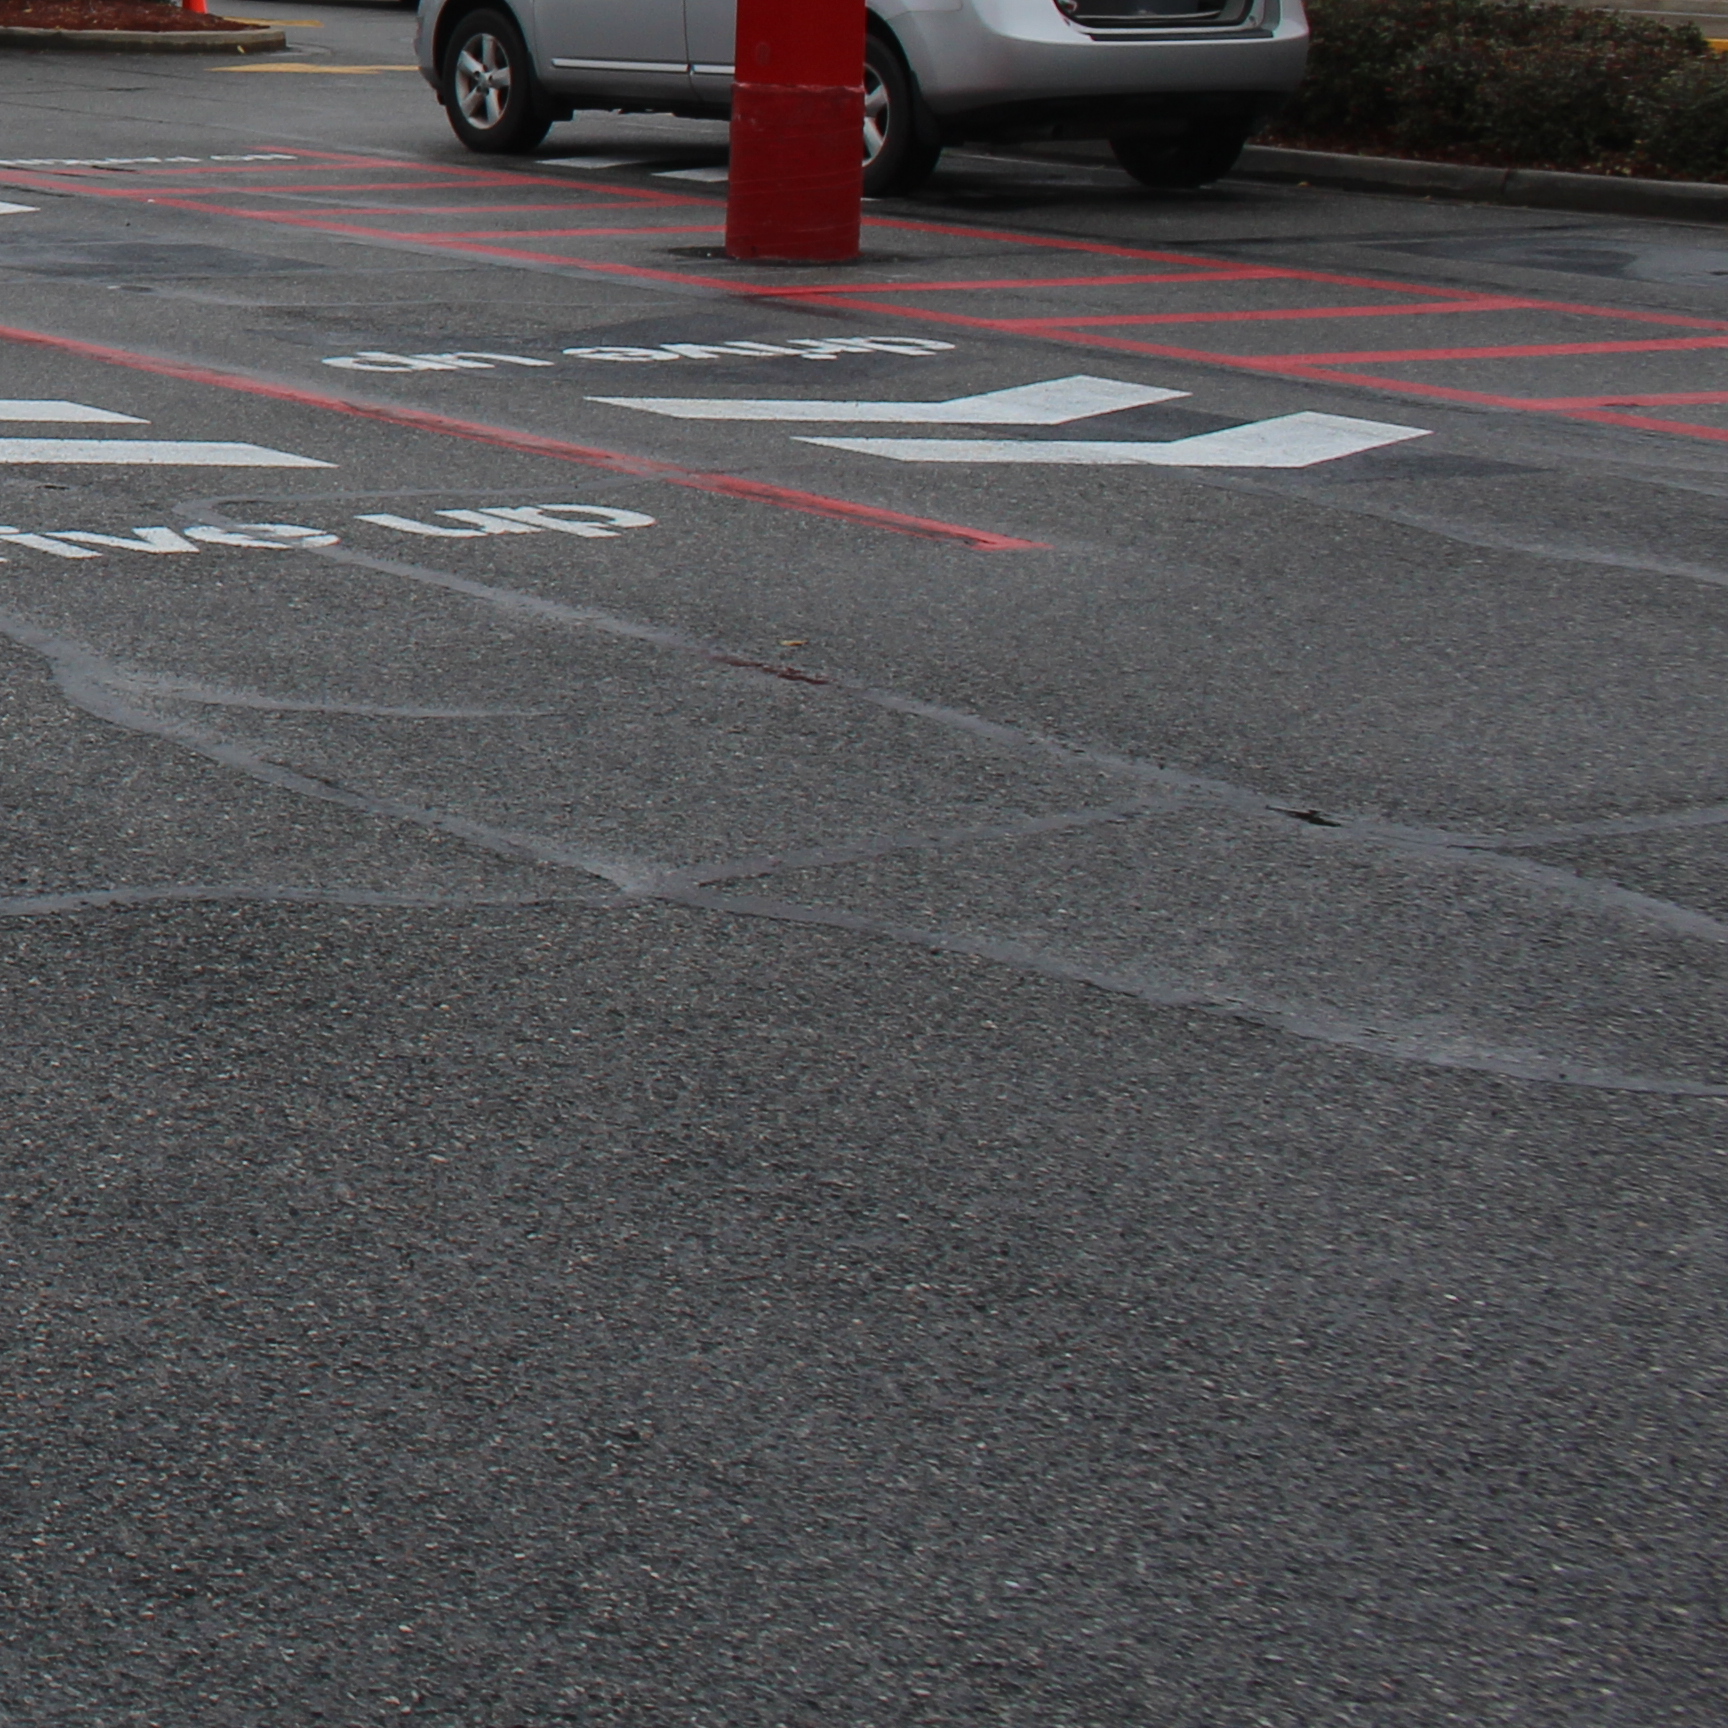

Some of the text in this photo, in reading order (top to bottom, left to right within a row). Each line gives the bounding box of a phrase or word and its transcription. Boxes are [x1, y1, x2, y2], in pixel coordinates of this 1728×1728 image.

[312, 336, 956, 373] drive up
[353, 503, 657, 538] up
